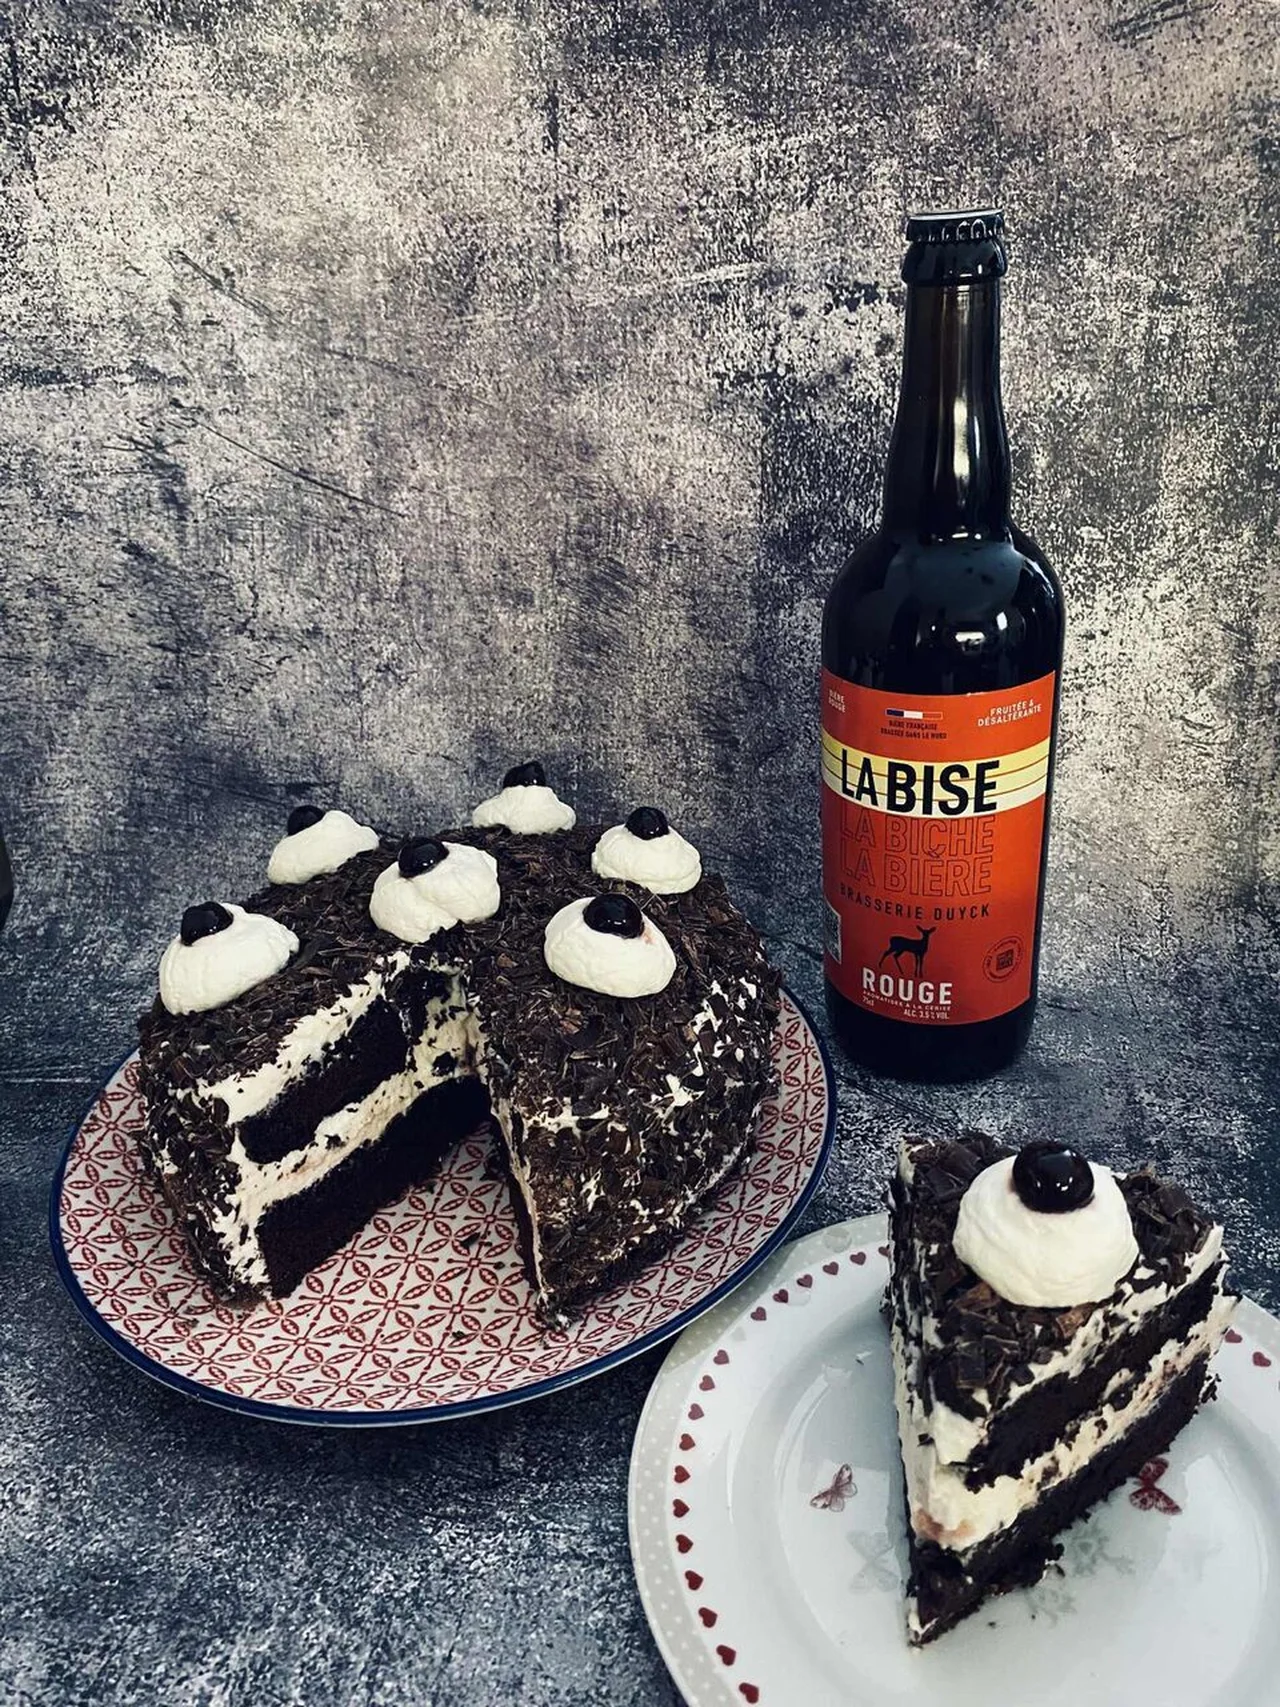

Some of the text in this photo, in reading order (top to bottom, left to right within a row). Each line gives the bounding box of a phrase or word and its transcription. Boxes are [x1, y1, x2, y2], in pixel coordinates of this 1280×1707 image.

[842, 748, 1000, 816] LA BISE
[841, 804, 996, 857] LA BICHE
[841, 836, 993, 898] LA BIÈRE
[840, 882, 990, 921] BRASSERIE DUYCK
[863, 967, 953, 1005] ROUGE
